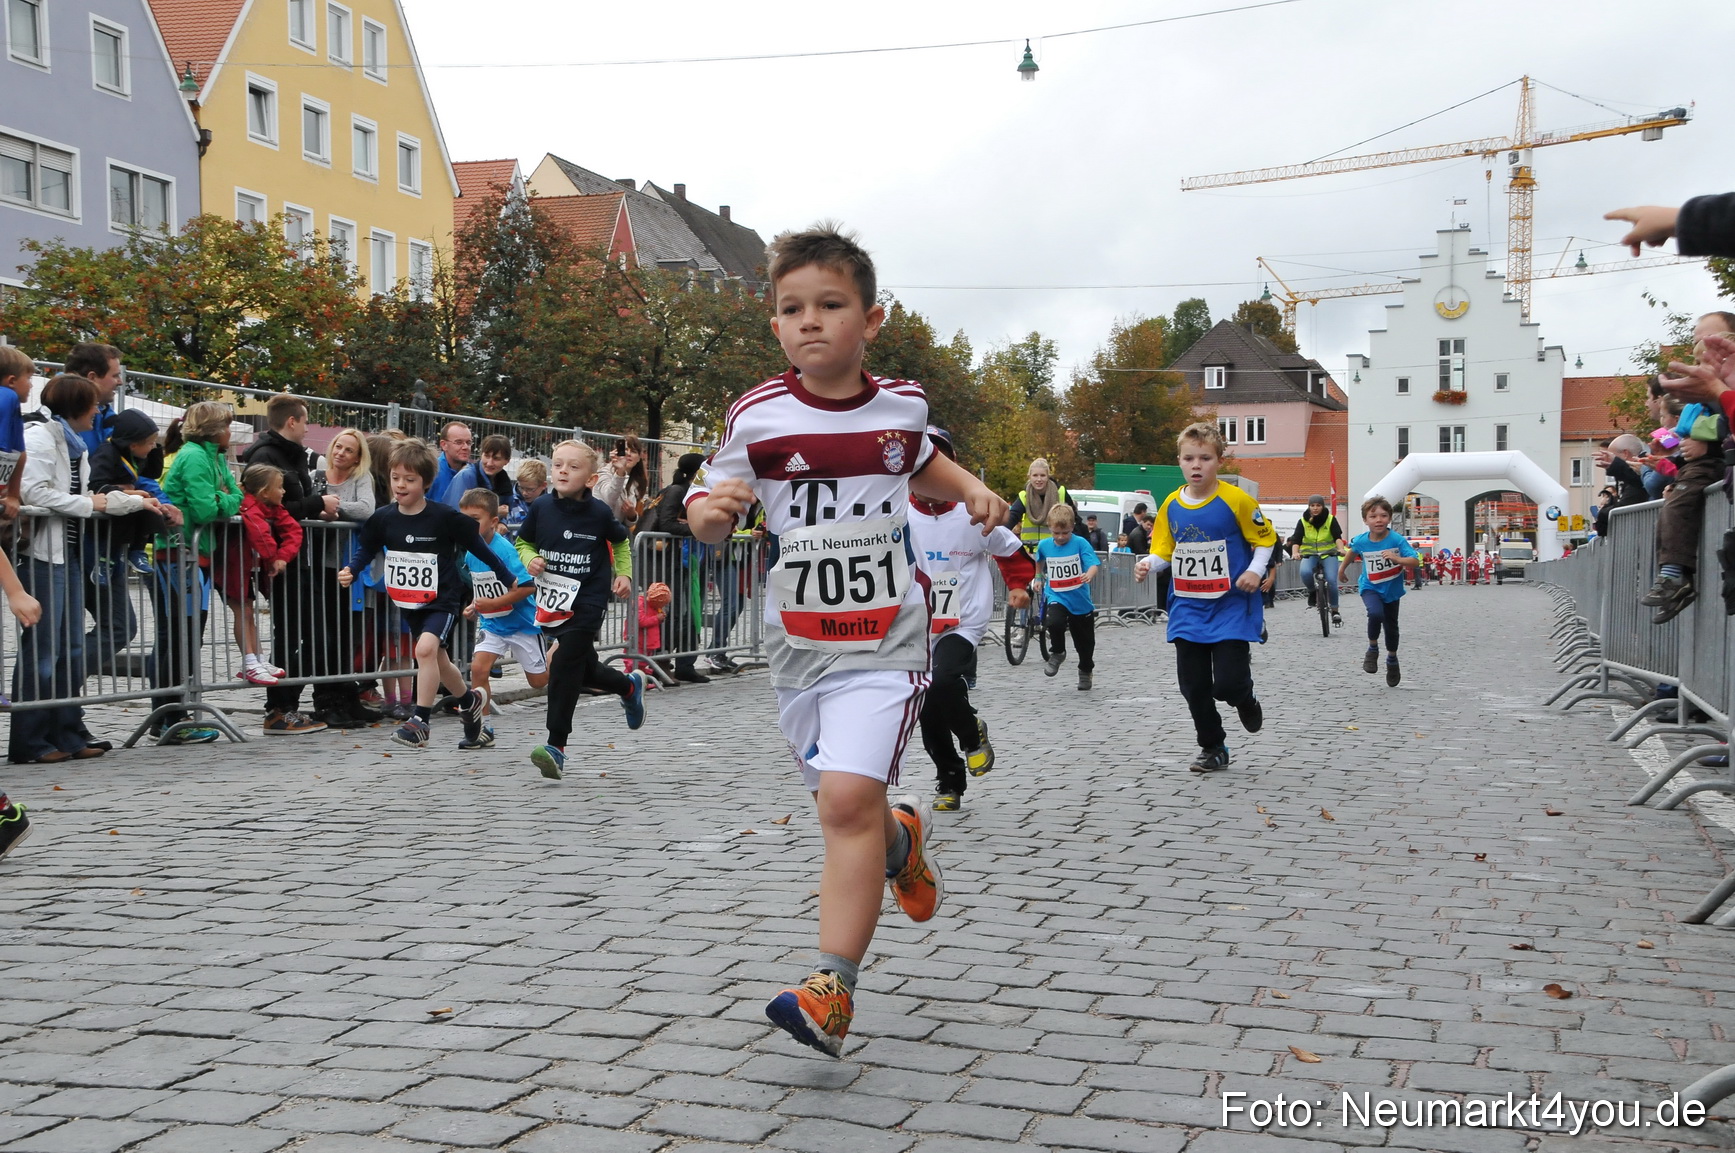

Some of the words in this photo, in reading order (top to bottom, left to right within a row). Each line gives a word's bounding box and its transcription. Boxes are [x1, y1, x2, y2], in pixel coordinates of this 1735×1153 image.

[785, 464, 810, 472] adidas
[822, 533, 887, 550] Neumarkt
[400, 556, 428, 564] Neumarkt
[949, 549, 974, 557] energie
[1050, 563, 1079, 579] 7090
[1175, 555, 1224, 577] 7214
[388, 565, 433, 588] 7538
[542, 577, 570, 590] Neumarkt
[785, 551, 897, 606] 7051
[1186, 582, 1214, 590] Vincent
[820, 617, 879, 636] Moritz
